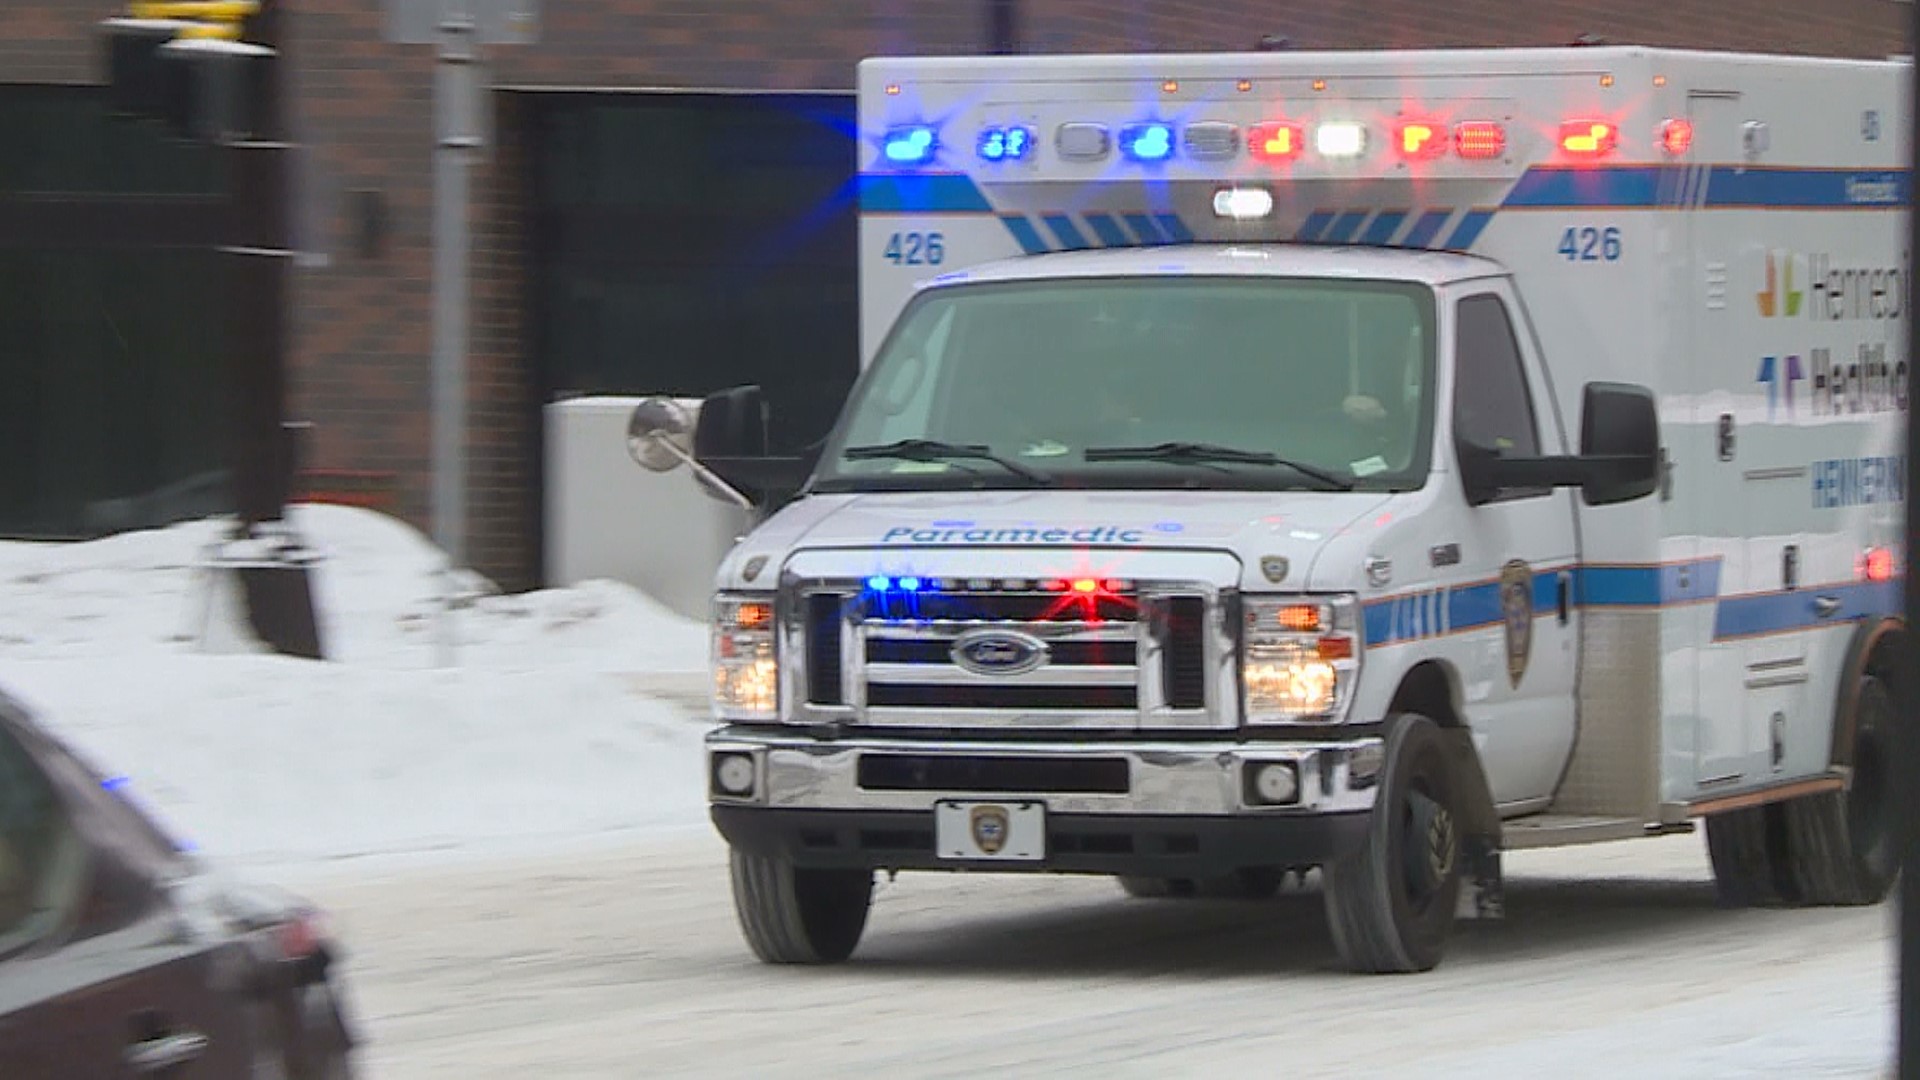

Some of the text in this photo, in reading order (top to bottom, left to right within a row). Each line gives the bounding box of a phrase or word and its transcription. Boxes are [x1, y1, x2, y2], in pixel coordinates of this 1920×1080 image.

[882, 231, 944, 265] 426
[1557, 227, 1621, 260] 426
[883, 526, 1143, 543] Paramedic
